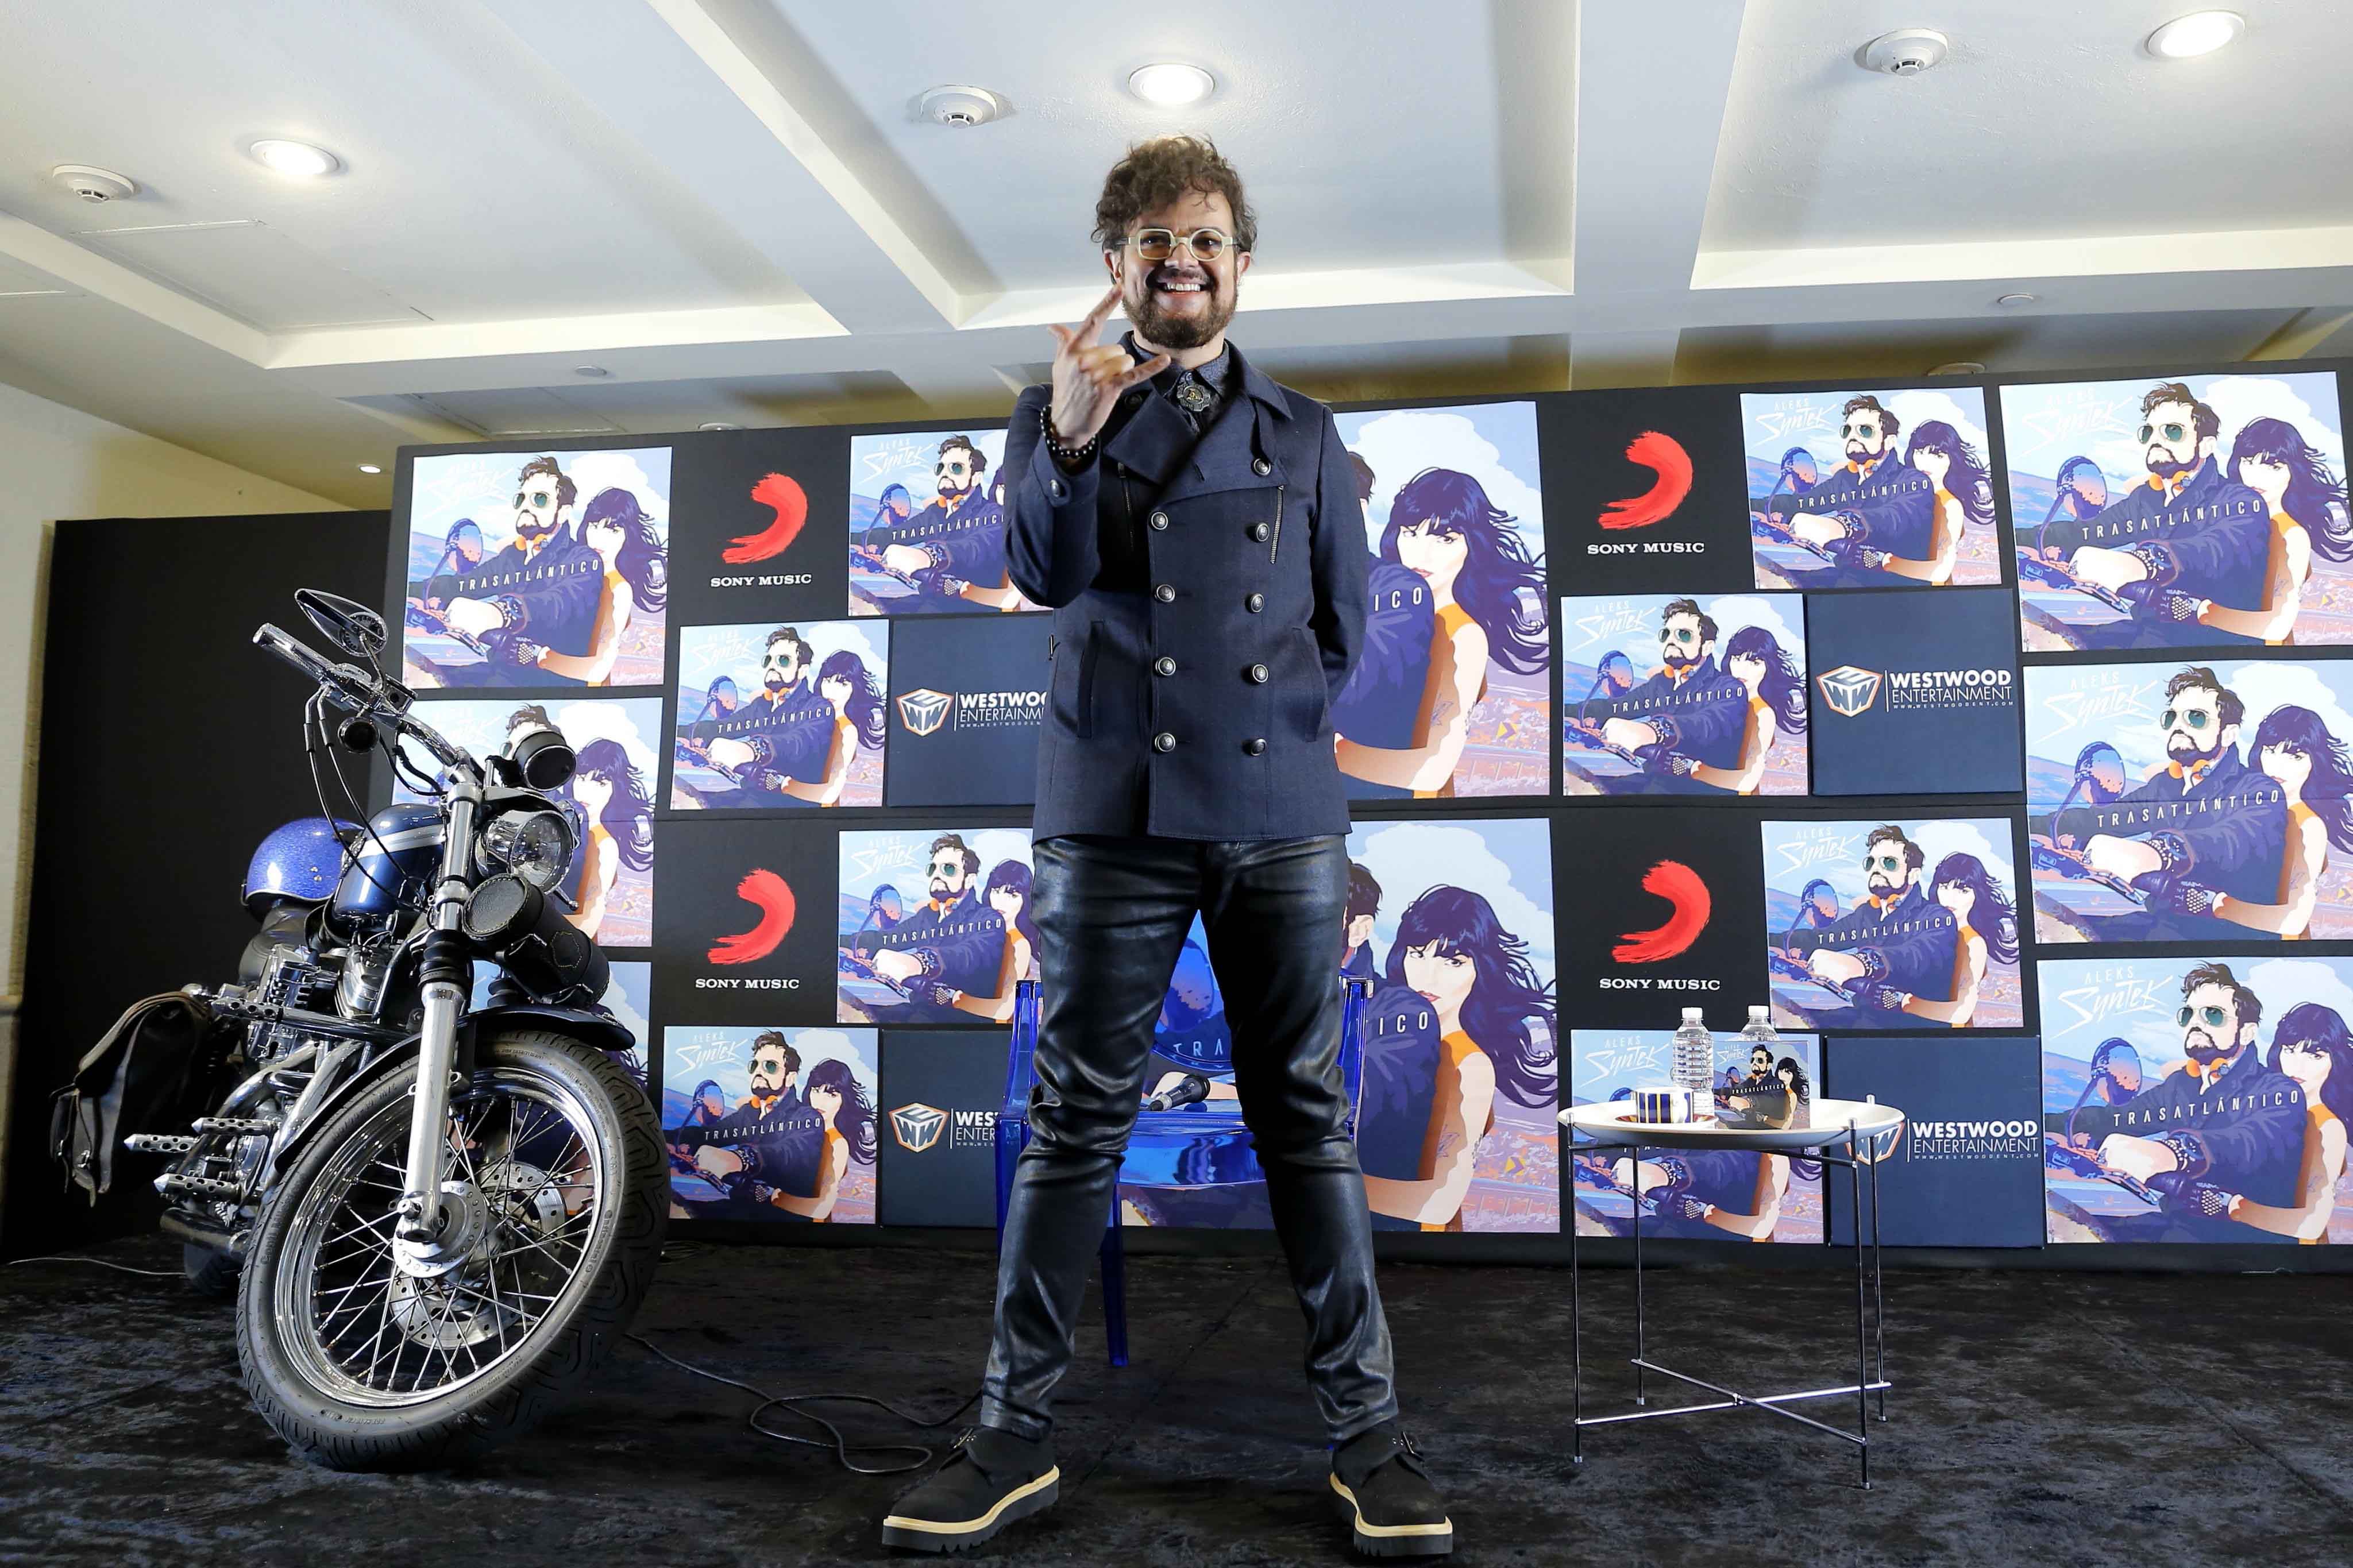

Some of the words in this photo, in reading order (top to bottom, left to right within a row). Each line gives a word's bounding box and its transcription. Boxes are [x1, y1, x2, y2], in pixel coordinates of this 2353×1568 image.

[2082, 500, 2261, 540] TRASATLÁNTICO
[1587, 543, 1638, 554] SONY
[1643, 542, 1704, 553] MUSIC
[459, 559, 599, 592] TRASATLÁNTICO
[711, 576, 755, 587] SONY
[758, 574, 812, 585] MUSIC
[1890, 670, 2012, 688] WESTWOOD
[960, 692, 1047, 708] WESTWO
[1892, 686, 2012, 704] ENTERTAINMENT
[960, 707, 1044, 723] ENTERTAINM
[2098, 790, 2278, 828] TRASATLÁNTICO
[696, 978, 740, 988] SONY
[745, 979, 799, 989] MUSIC
[2085, 965, 2133, 984] ALEKS
[1599, 978, 1652, 989] SONY
[1657, 979, 1720, 991] MUSIC
[2114, 1090, 2298, 1127] TRASATLÁNTICO
[1912, 1120, 2038, 1138] WESTWOOD
[1914, 1137, 2038, 1153] ENTERTAINMENT
